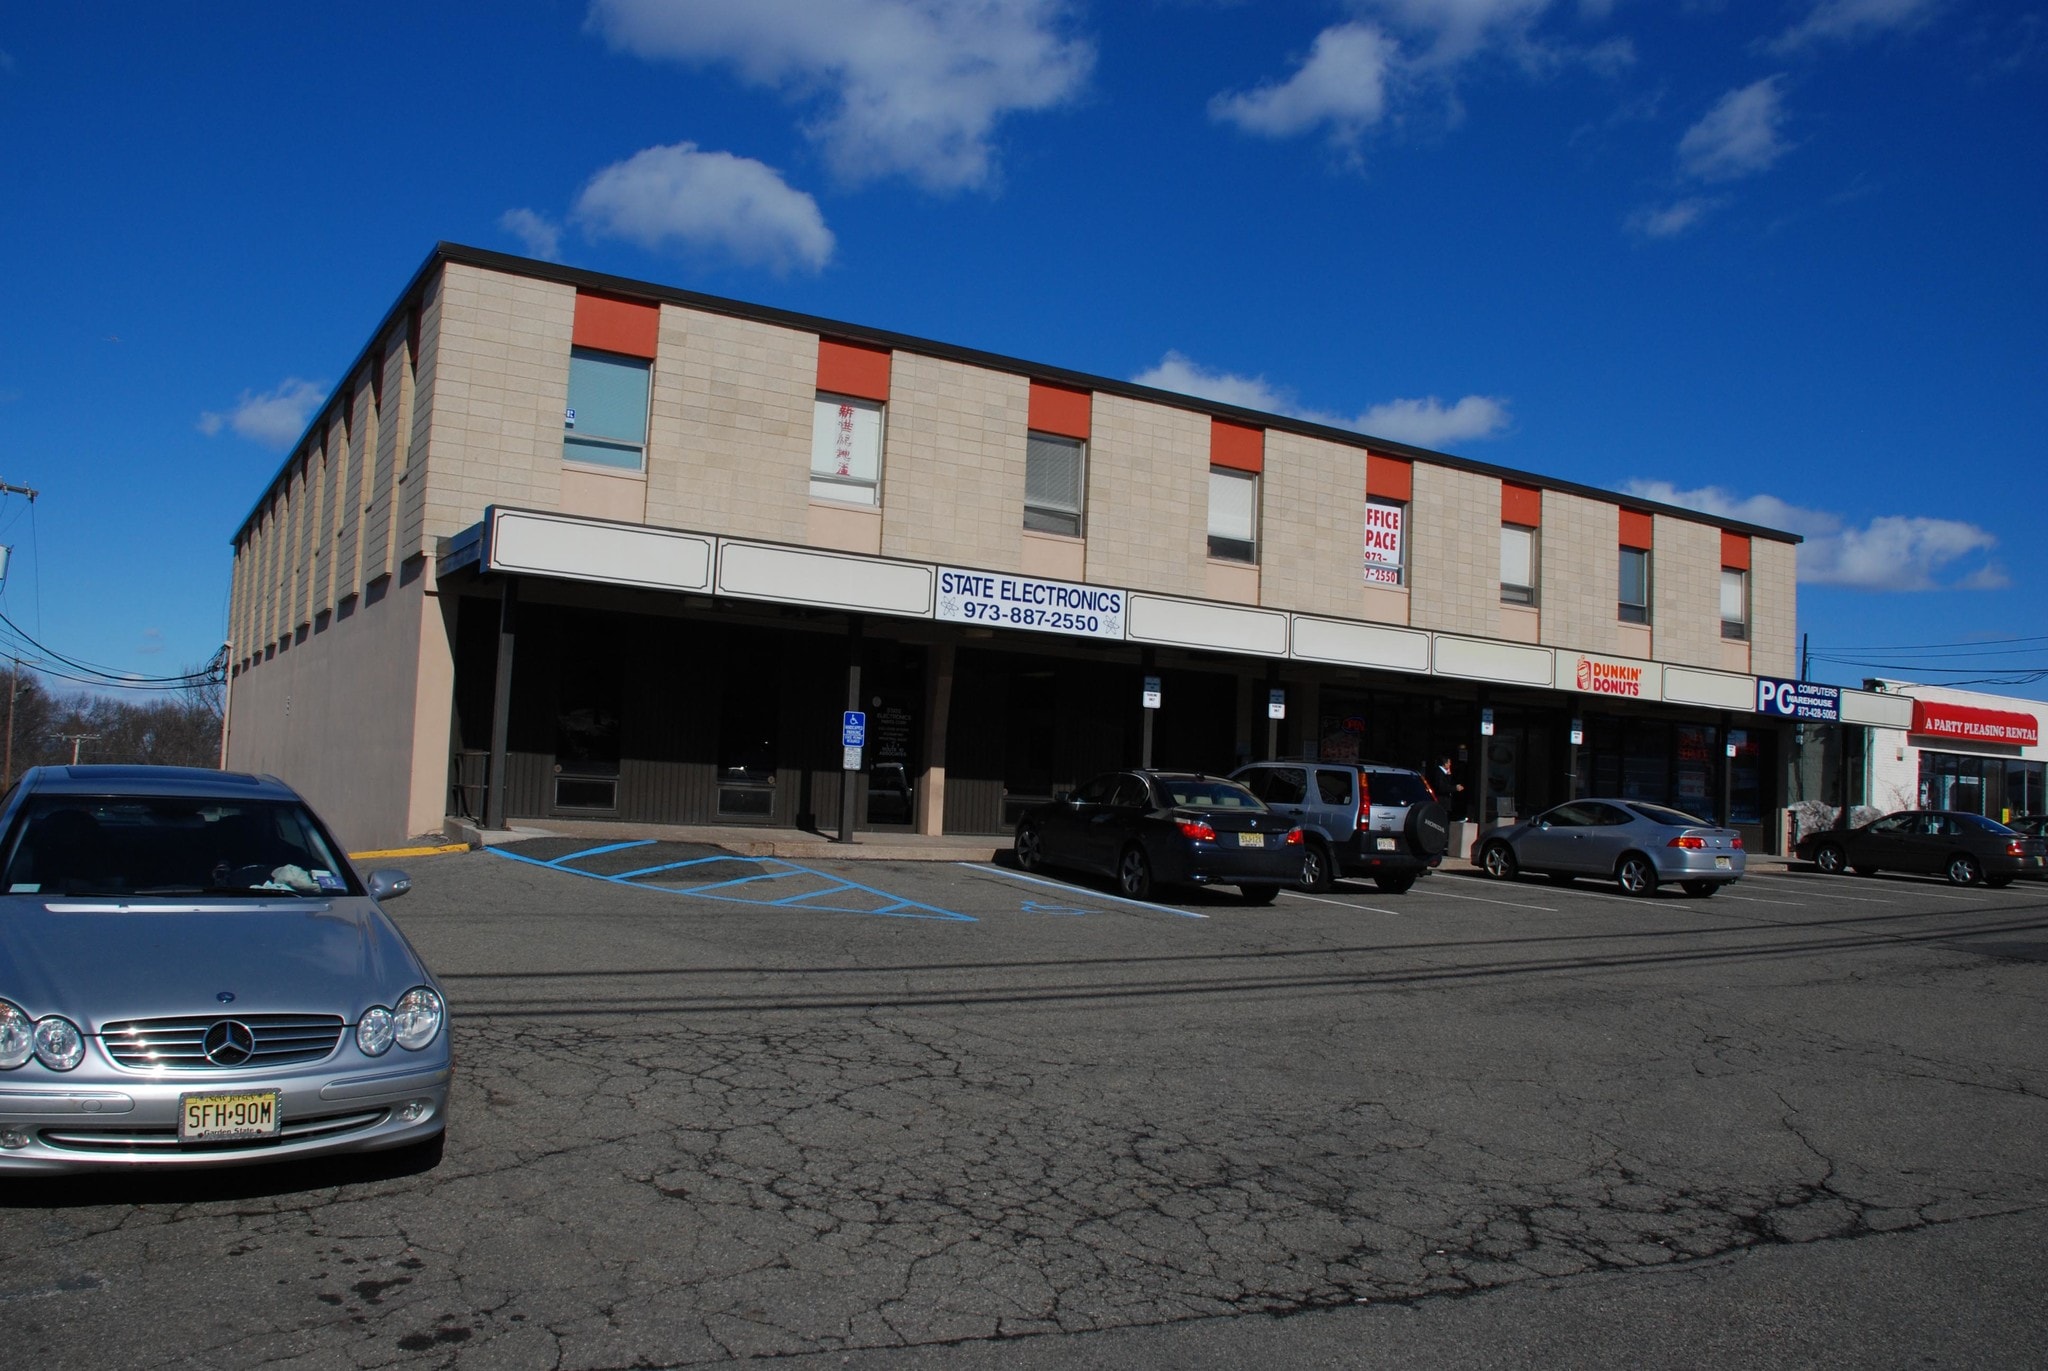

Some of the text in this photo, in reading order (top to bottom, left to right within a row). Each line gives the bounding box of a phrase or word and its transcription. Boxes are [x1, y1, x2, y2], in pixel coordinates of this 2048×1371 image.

[941, 572, 1121, 614] STATE ELECTRONICS
[963, 601, 1099, 632] 973-887-2550
[1593, 662, 1642, 681] DUNKIN'
[1593, 677, 1639, 697] DONUTS
[1797, 684, 1838, 698] COMPUTERS
[1758, 680, 1795, 715] PC
[1786, 694, 1833, 708] WAREHOUSE
[1925, 717, 2037, 741] A PARTY PLEASING RENTAL
[1424, 818, 1446, 834] HONDA
